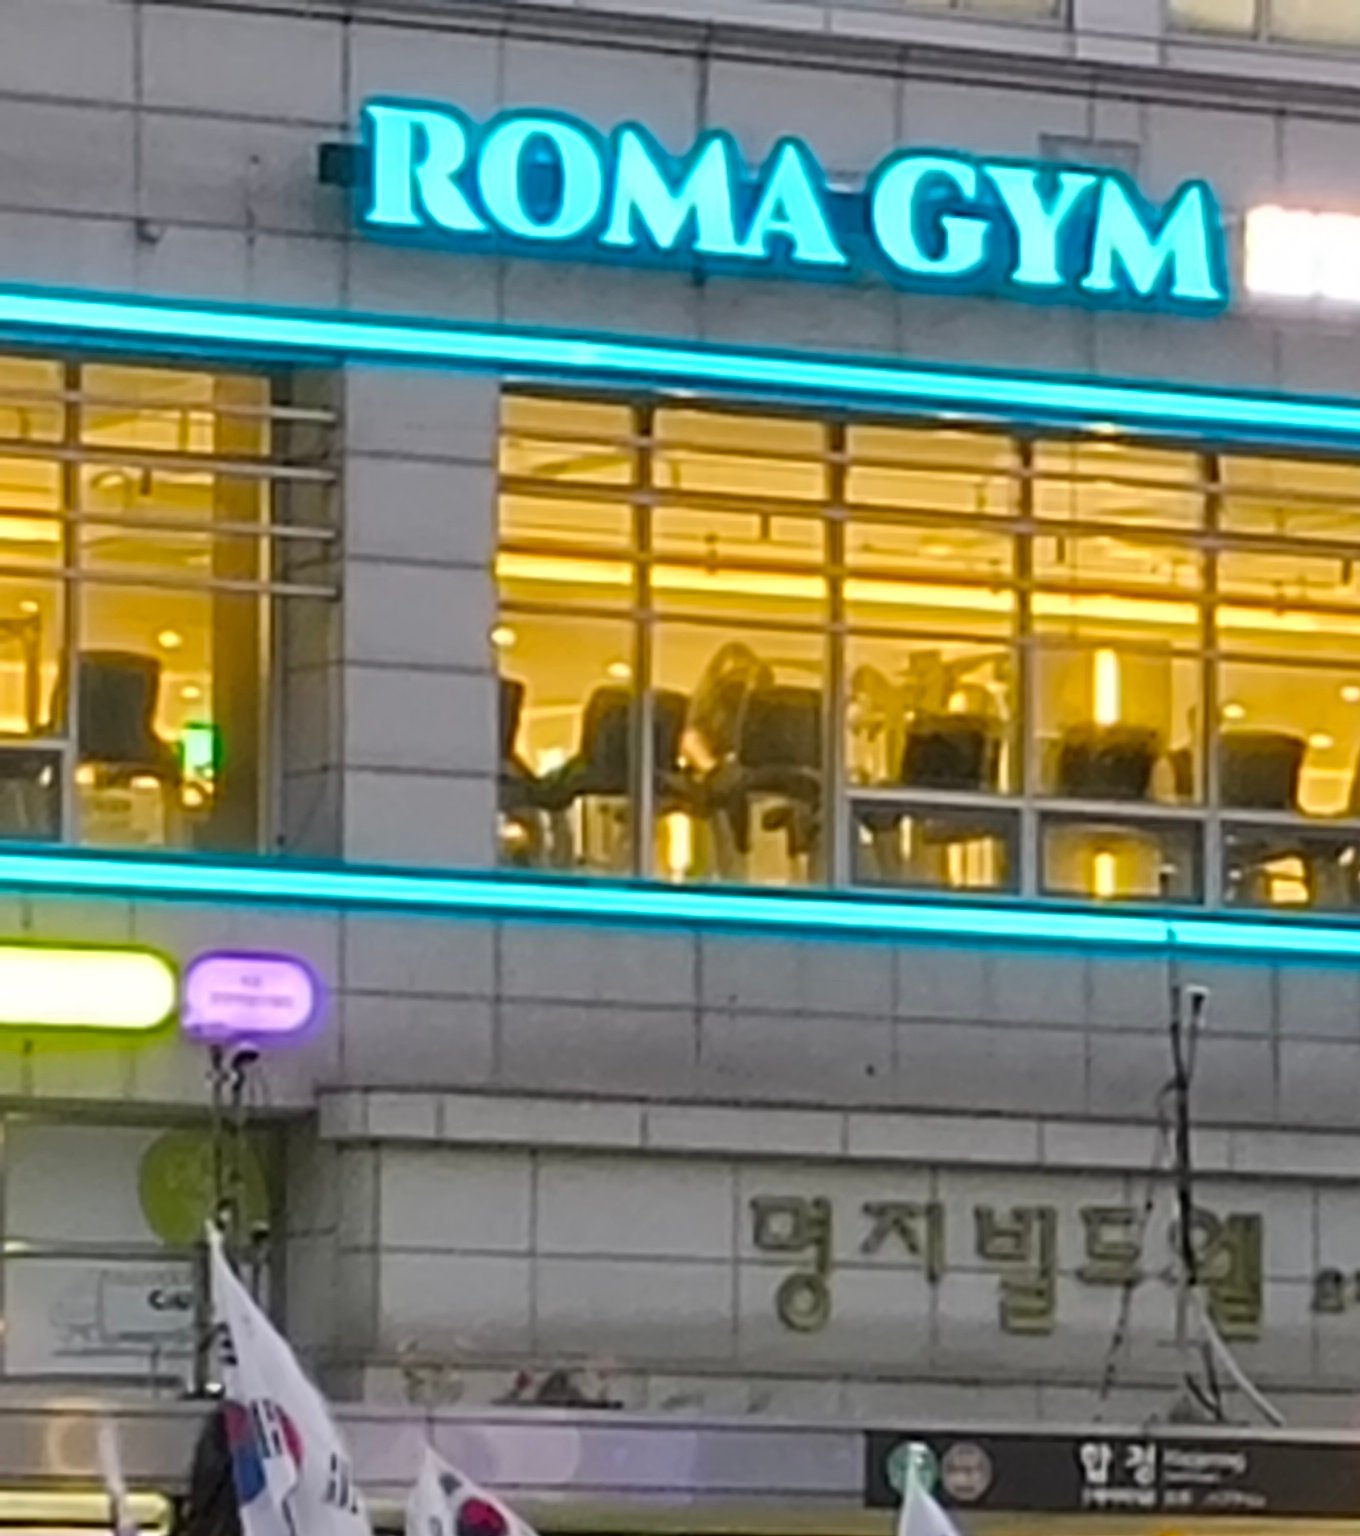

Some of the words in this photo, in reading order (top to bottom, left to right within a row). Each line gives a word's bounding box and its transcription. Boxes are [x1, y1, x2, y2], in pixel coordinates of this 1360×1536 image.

[361, 103, 850, 266] ROMA
[870, 155, 1223, 301] GYM
[748, 1194, 1265, 1344] 명지빌드웰
